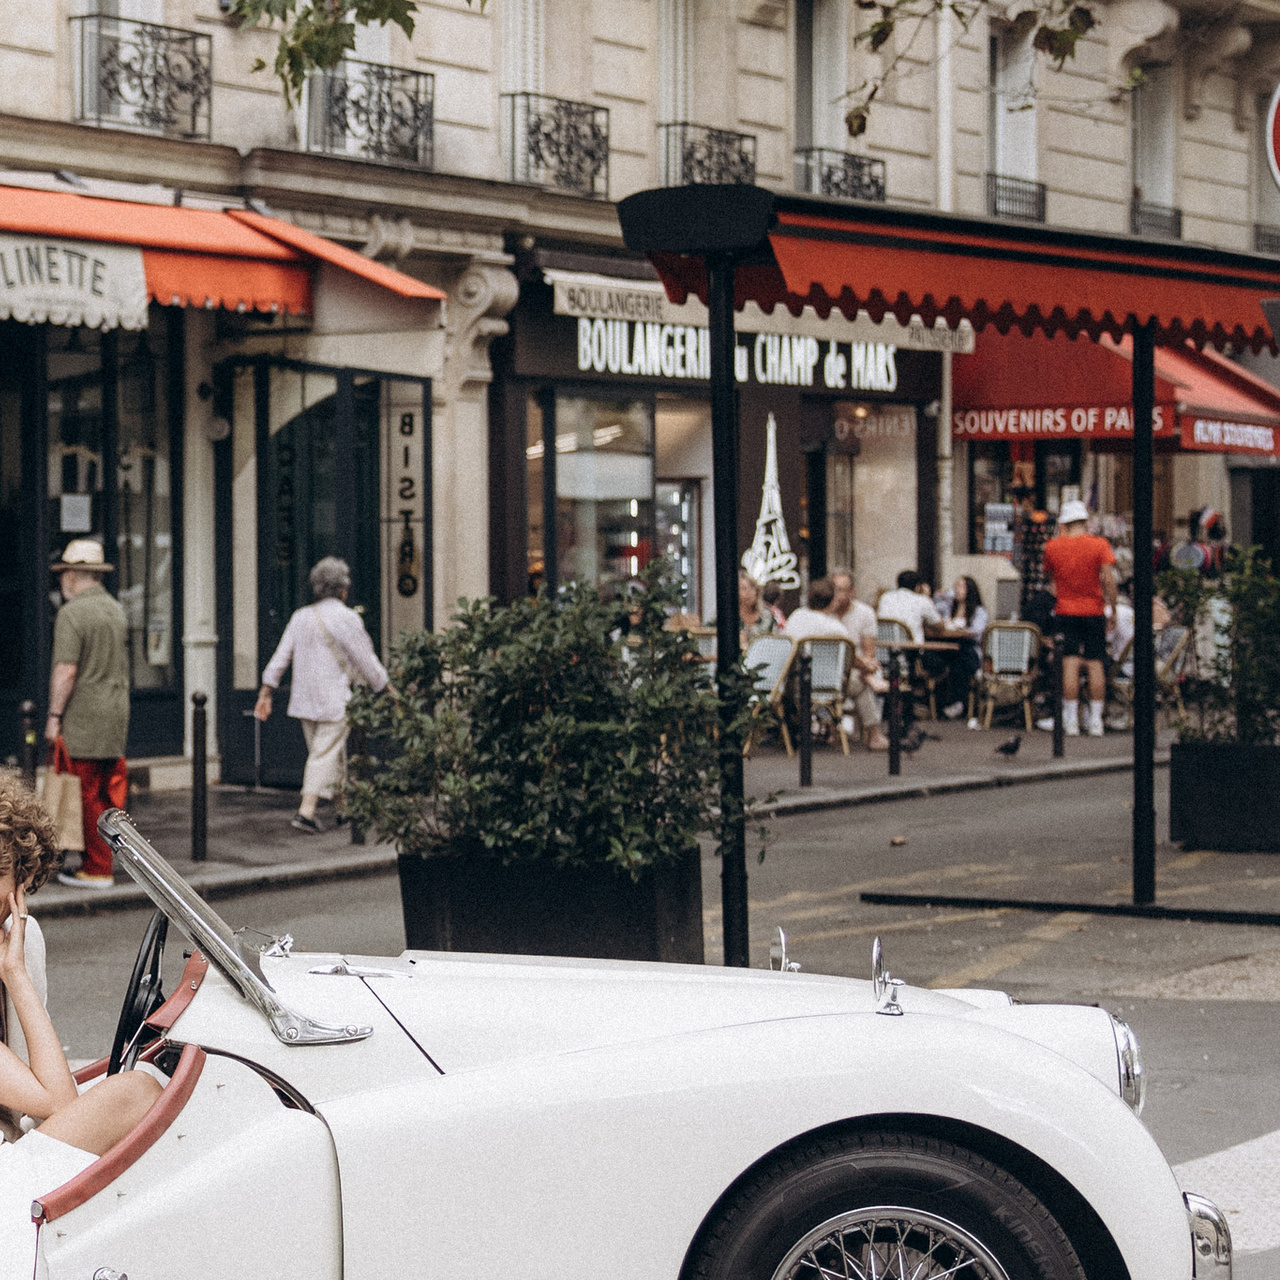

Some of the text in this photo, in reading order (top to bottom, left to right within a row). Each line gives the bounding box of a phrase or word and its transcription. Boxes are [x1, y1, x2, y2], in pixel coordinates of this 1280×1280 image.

[0, 245, 106, 297] LINETTE
[567, 286, 664, 319] BOULANGERIE
[734, 345, 749, 383] u
[754, 333, 819, 386] CHAMP
[824, 339, 847, 389] de
[851, 342, 898, 393] MARS
[953, 405, 1163, 433] SOUVENIRS OF PAS
